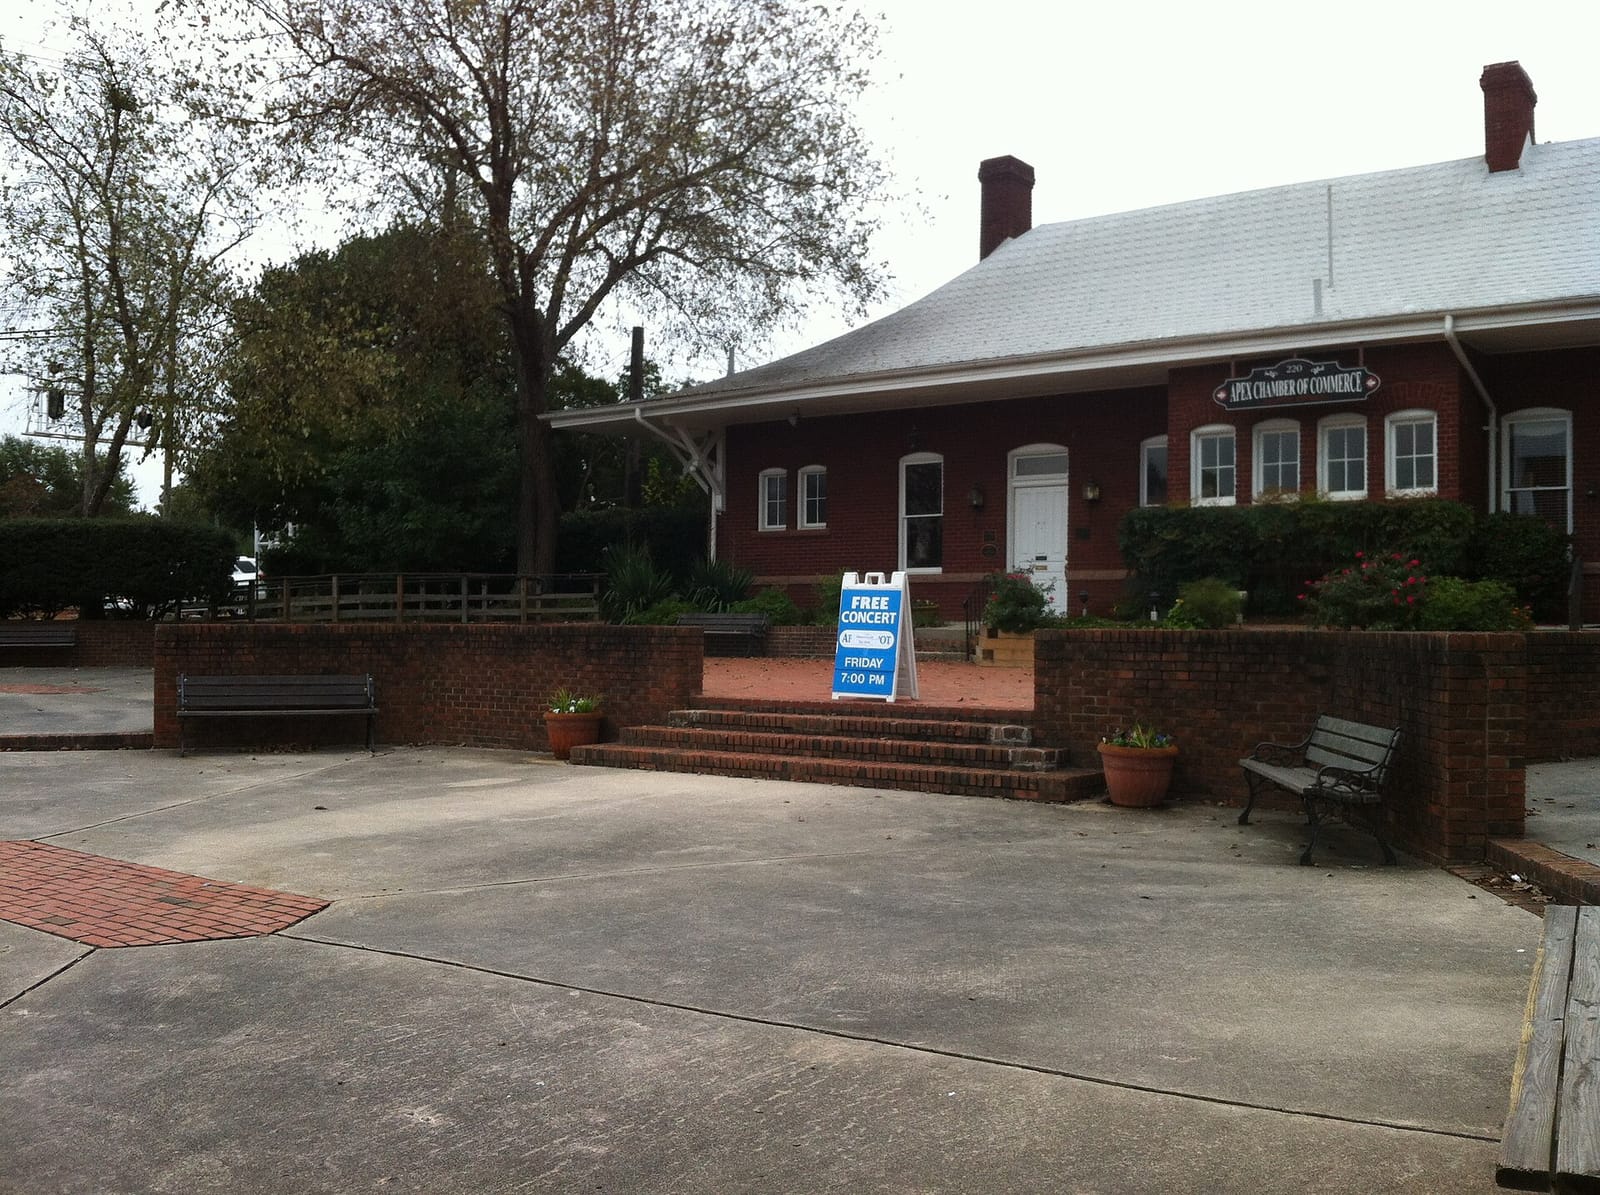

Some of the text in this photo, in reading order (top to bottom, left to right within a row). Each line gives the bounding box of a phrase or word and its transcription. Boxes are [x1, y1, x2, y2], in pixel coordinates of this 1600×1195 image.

[1286, 365, 1302, 374] 220
[1230, 371, 1362, 402] APEX CHAMBER OF COMMERCE
[851, 596, 890, 610] FREE
[841, 611, 897, 624] CONCERT
[844, 657, 884, 668] FRIDAY
[841, 673, 885, 685] 7:00 PM
